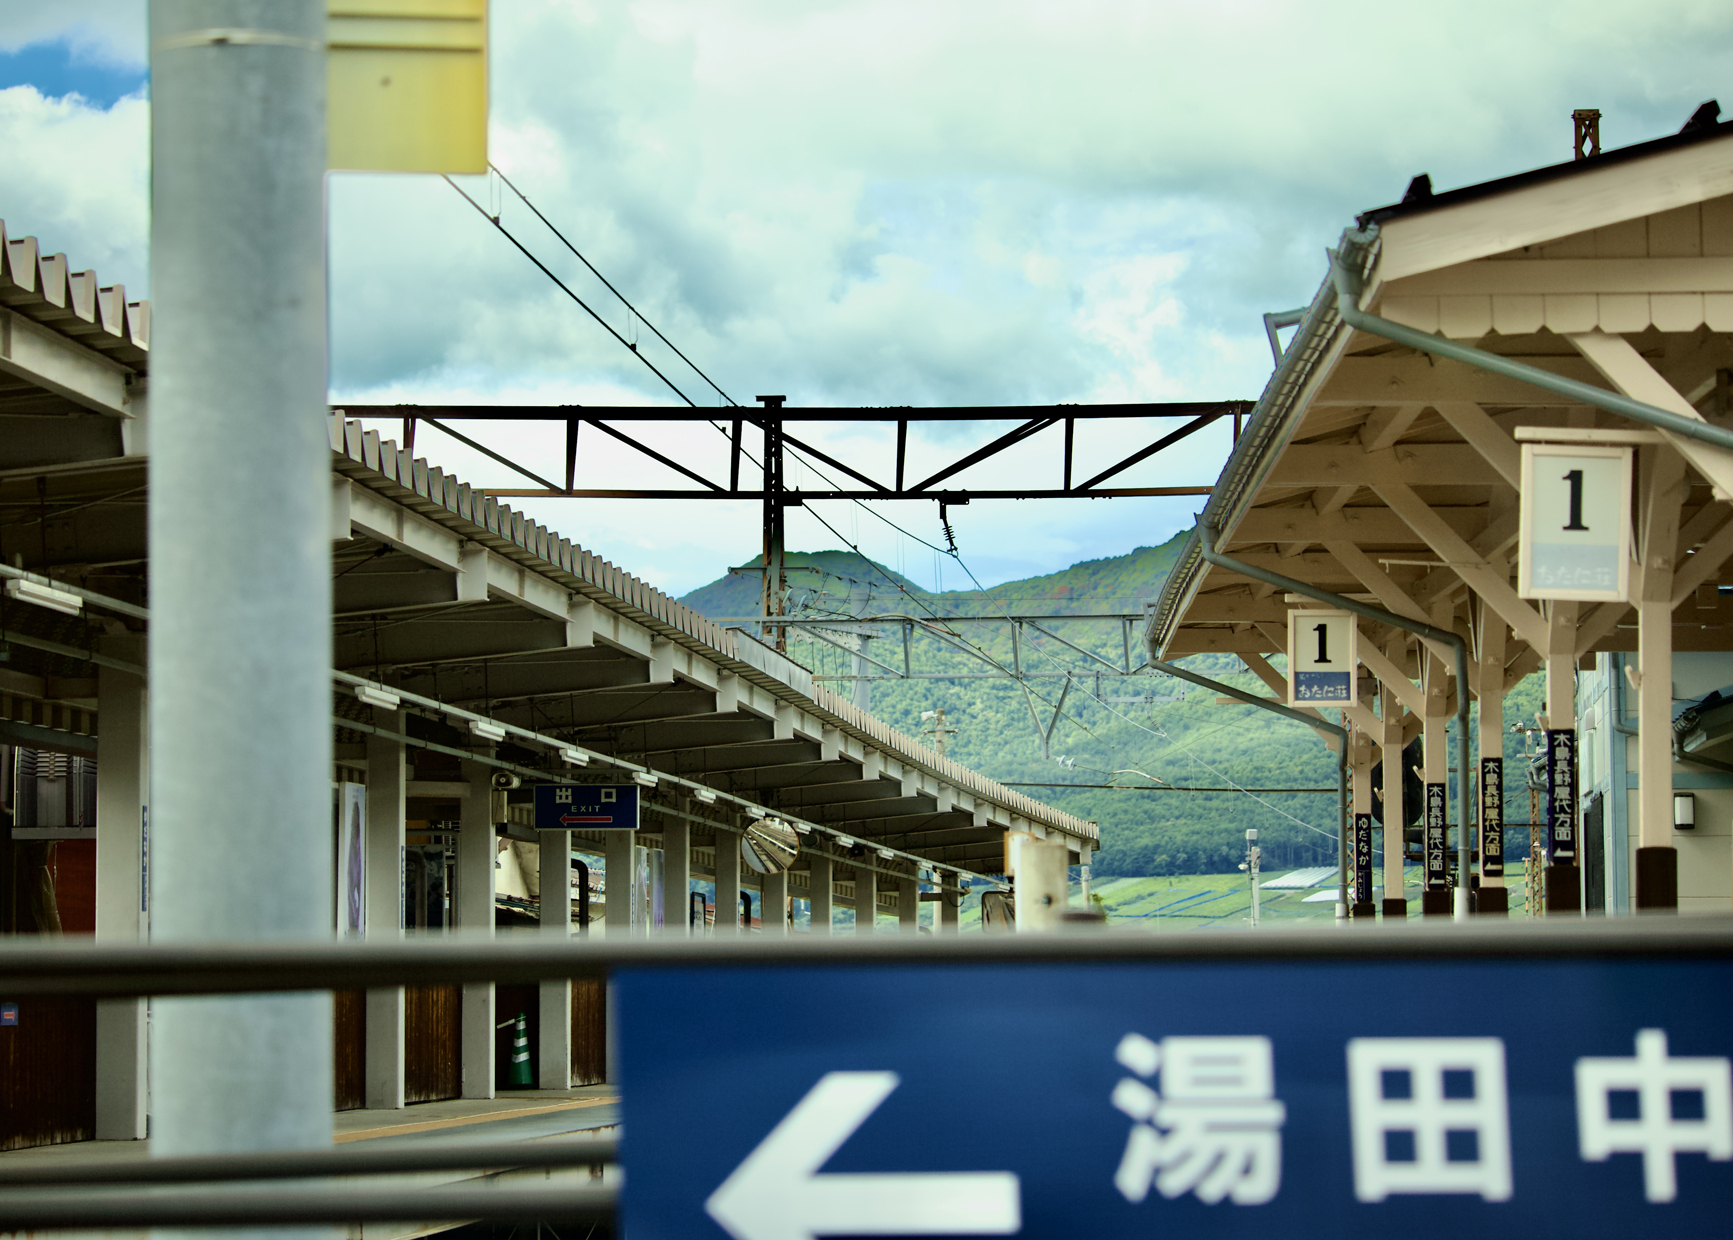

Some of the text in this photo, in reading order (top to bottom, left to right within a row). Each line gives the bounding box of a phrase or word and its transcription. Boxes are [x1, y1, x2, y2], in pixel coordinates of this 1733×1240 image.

[1561, 469, 1590, 531] 1
[1312, 623, 1332, 663] 1
[1298, 684, 1348, 698] おたに荘
[555, 787, 617, 804] 出口
[571, 805, 600, 813] EXIT
[1484, 761, 1500, 856] 木島長野屋代方面
[1553, 732, 1572, 841] 木島長野屋代方面
[1358, 817, 1369, 866] ゆだなか
[1429, 785, 1443, 871] 木島長野屋代方面
[1110, 1028, 1733, 1204] 湯田中
